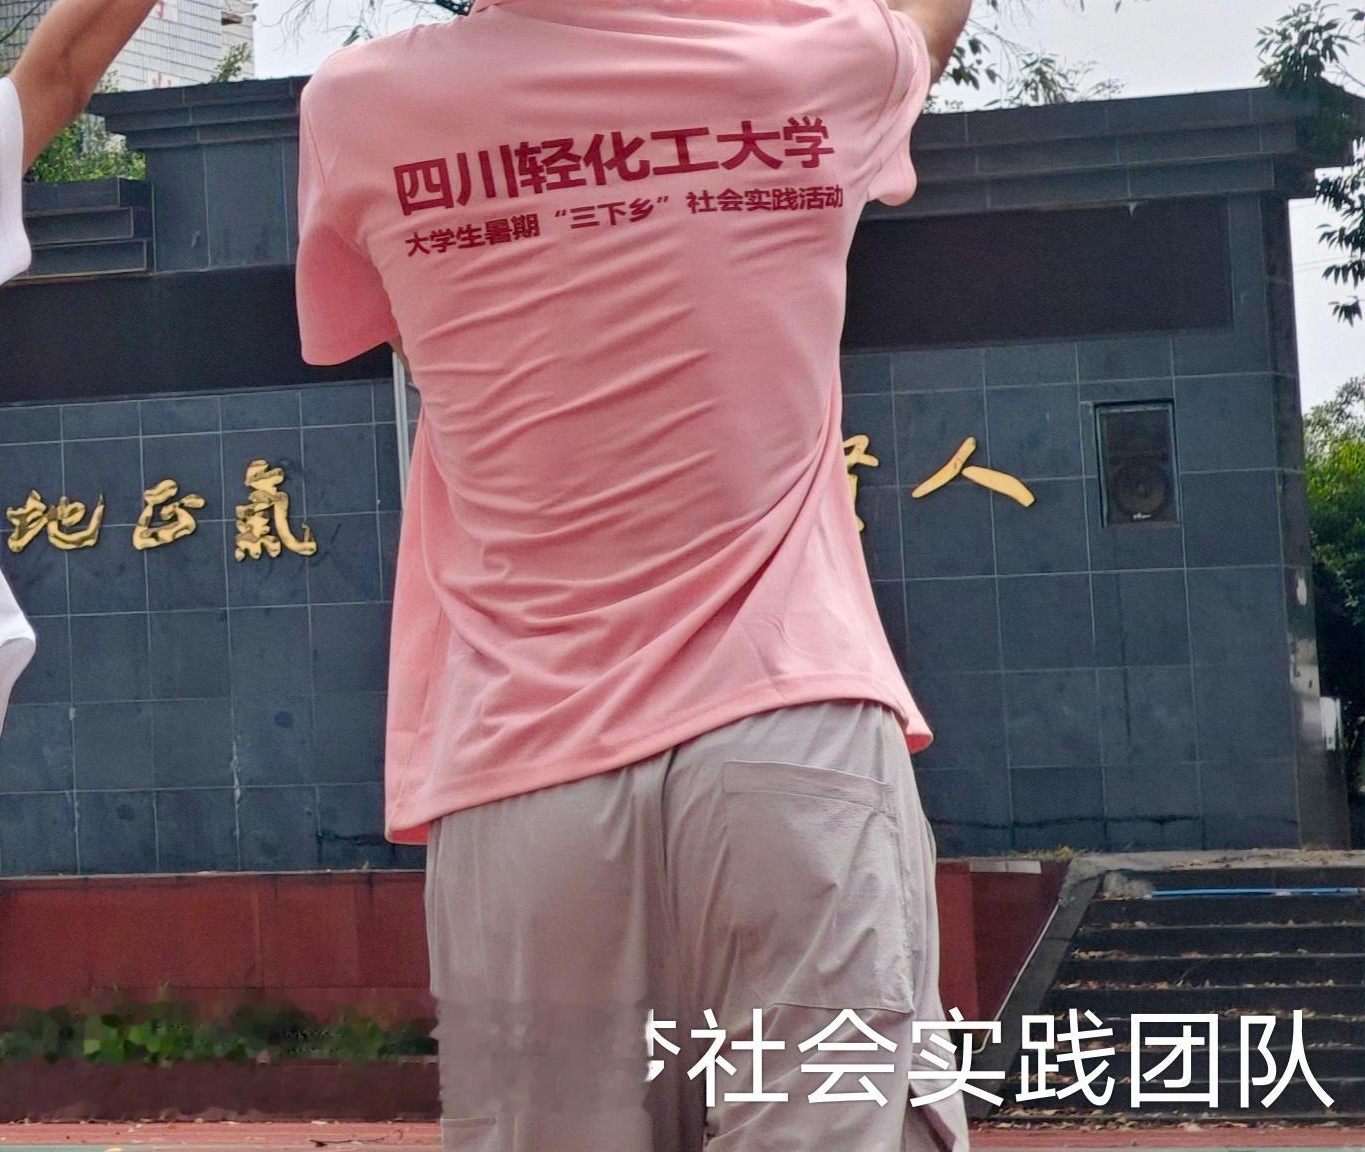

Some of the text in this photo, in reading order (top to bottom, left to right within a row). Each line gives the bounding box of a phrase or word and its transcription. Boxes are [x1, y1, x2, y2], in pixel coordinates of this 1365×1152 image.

[393, 116, 835, 216] 四川轻化工大学
